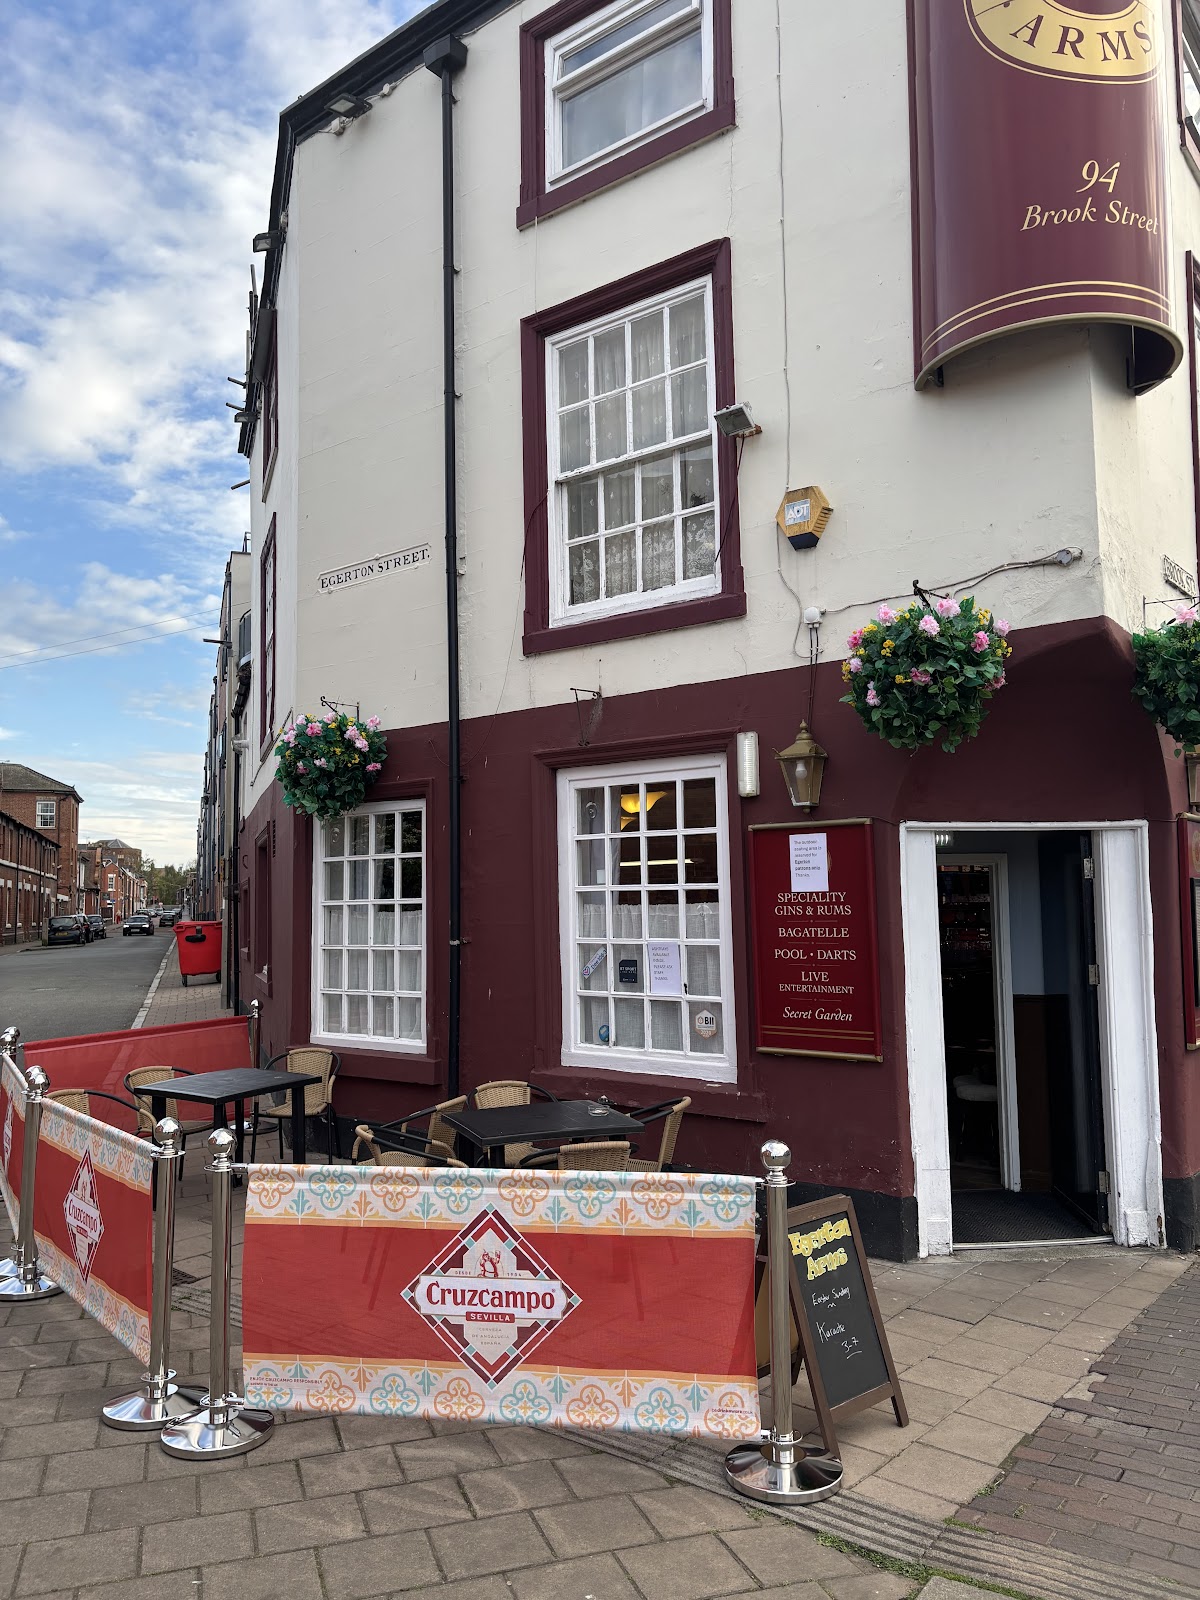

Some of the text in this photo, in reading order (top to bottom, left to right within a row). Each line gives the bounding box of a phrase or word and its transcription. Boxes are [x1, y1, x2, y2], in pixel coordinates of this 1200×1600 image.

[1010, 15, 1153, 61] ARMS
[1076, 160, 1120, 193] 94
[1020, 197, 1159, 234] Brook Street
[787, 504, 809, 520] ADT
[320, 564, 374, 589] EGERTON
[777, 892, 847, 903] SPECIALITY
[774, 905, 852, 916] GINS & RUMS
[778, 927, 850, 938] BAGATELLE
[774, 949, 857, 961] POOL DARTS
[801, 971, 830, 982] LIVE
[779, 983, 855, 995] ENTERTAINMENT
[782, 1006, 853, 1022] Secret Garden
[69, 1199, 98, 1233] Cruzcampo
[788, 1217, 852, 1257] Egerton
[426, 1281, 555, 1313] Cruzcampo
[470, 1313, 511, 1322] SEVILLA
